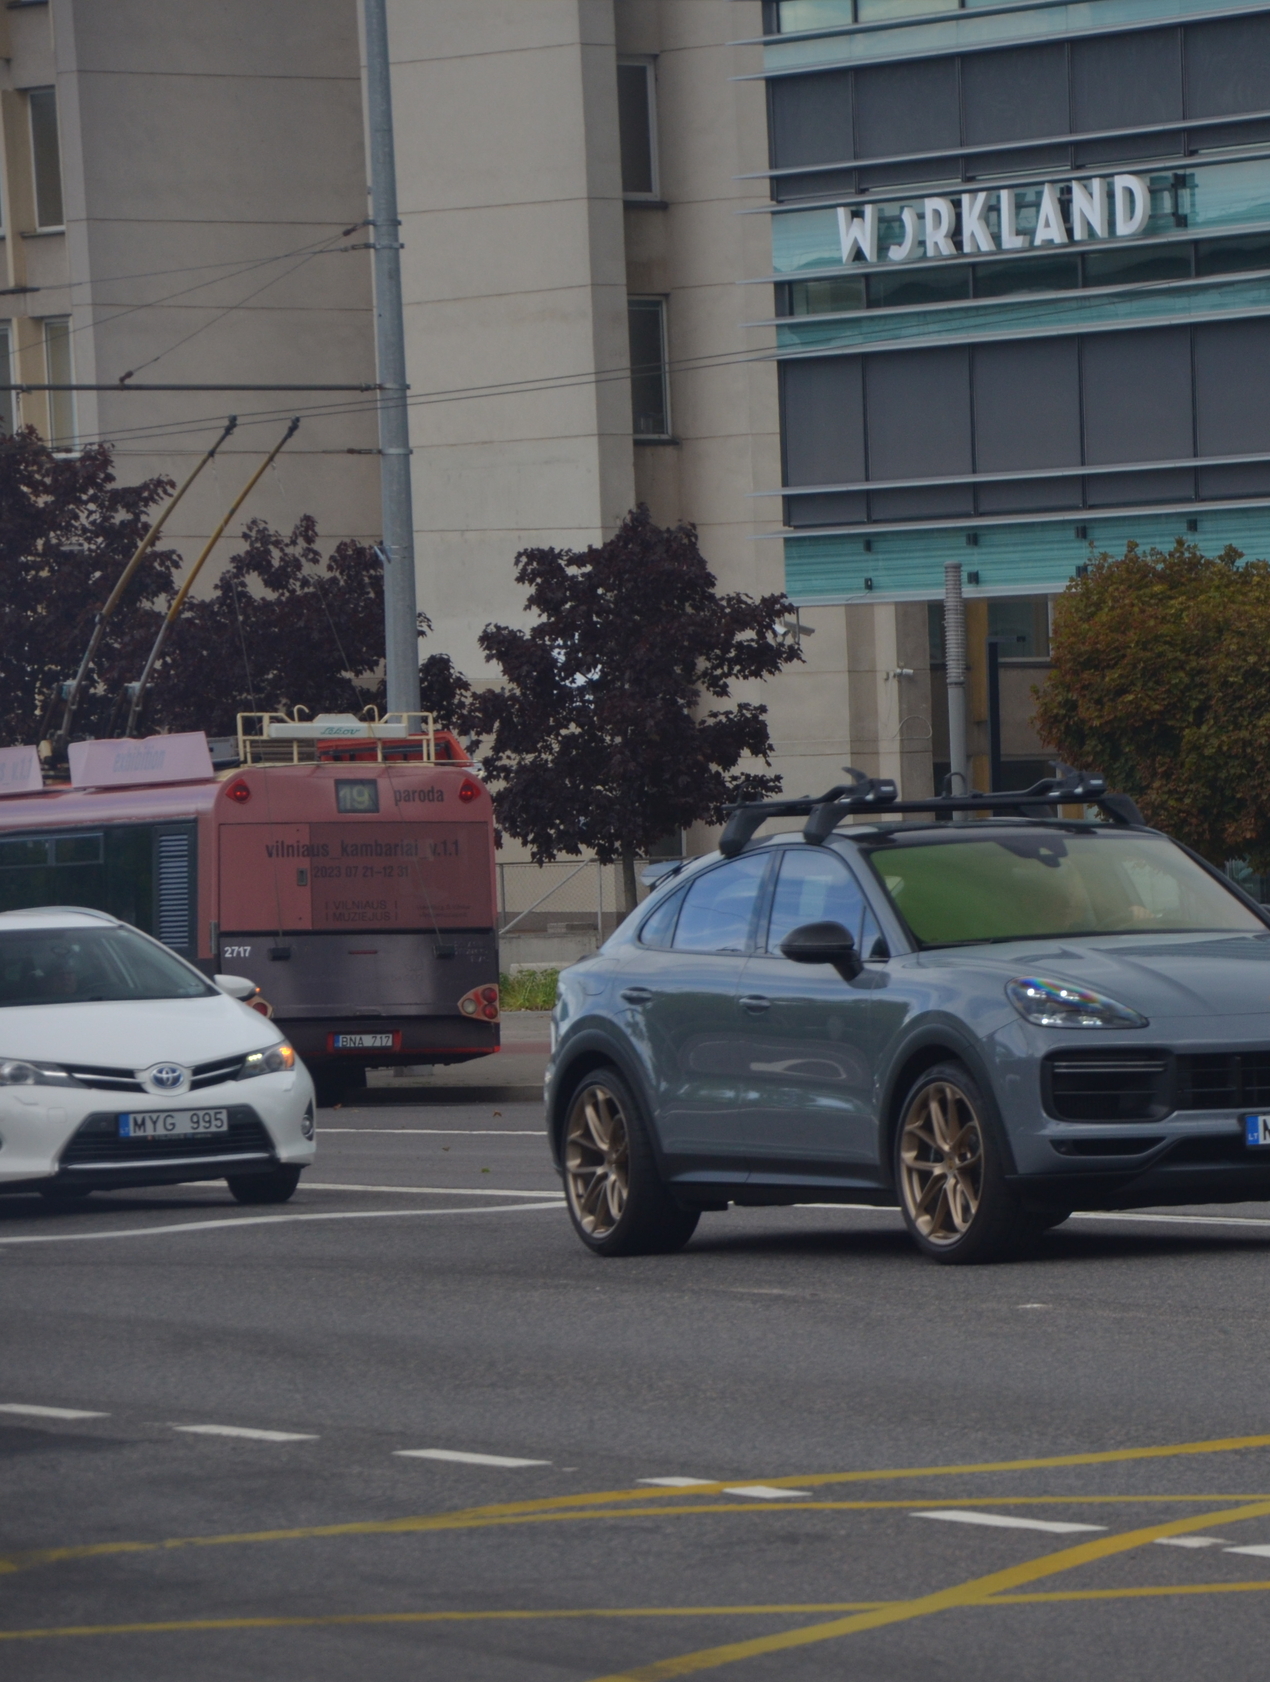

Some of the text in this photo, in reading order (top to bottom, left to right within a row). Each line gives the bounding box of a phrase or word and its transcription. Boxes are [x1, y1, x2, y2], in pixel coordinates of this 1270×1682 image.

[340, 785, 370, 810] 19
[394, 785, 444, 806] paroda
[313, 866, 342, 878] 2023
[345, 866, 359, 878] 07
[397, 865, 409, 877] 31
[333, 900, 387, 910] VILNIAUS
[332, 911, 391, 922] MUZIEJUS
[224, 946, 251, 957] 2717
[341, 1035, 390, 1047] BNA 717
[133, 1114, 176, 1134] MYG
[190, 1111, 224, 1131] 995
